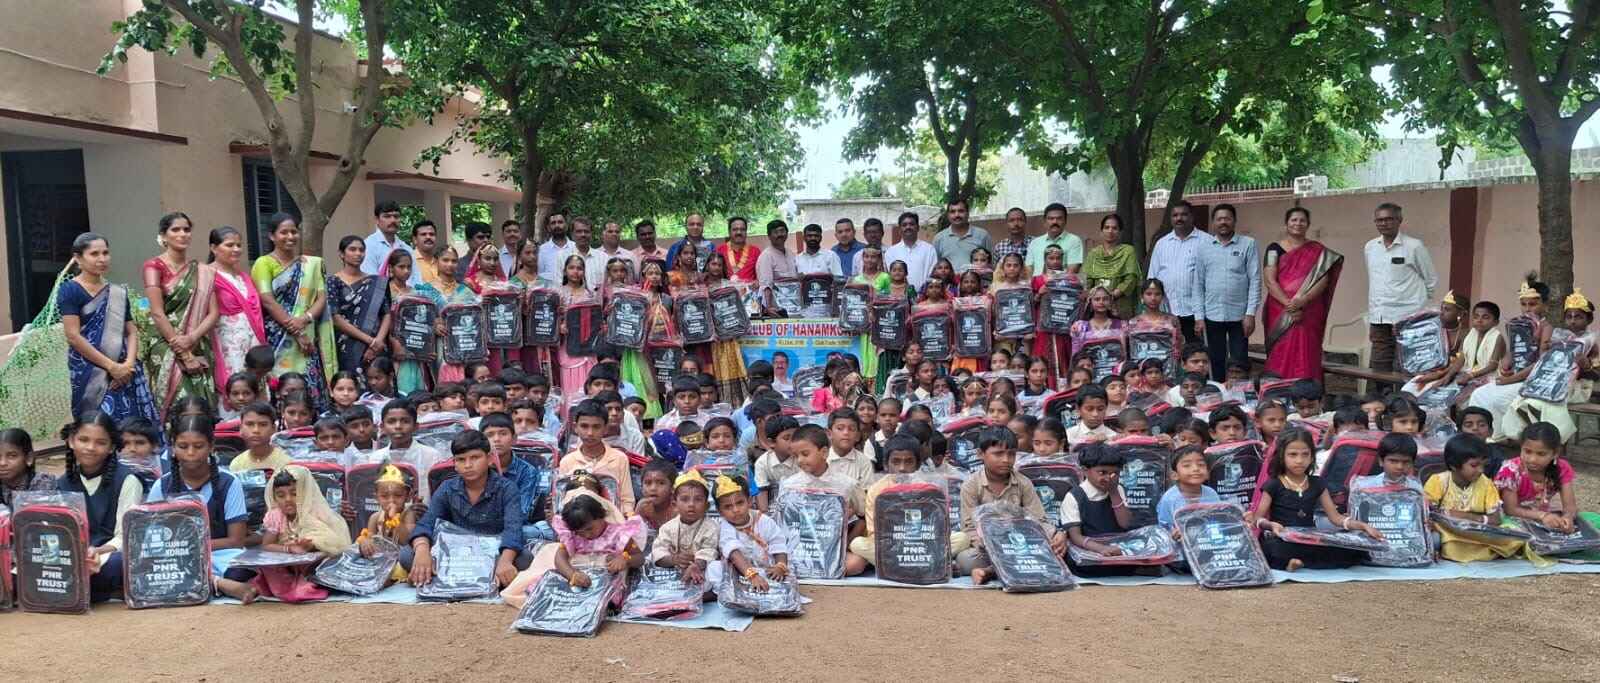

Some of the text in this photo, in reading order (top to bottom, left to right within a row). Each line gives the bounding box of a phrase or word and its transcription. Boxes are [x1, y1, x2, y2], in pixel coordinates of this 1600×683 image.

[776, 323, 789, 336] OF
[152, 563, 180, 572] PNR
[42, 571, 63, 579] PNR
[146, 571, 186, 581] TRUST
[36, 579, 68, 588] TRUST
